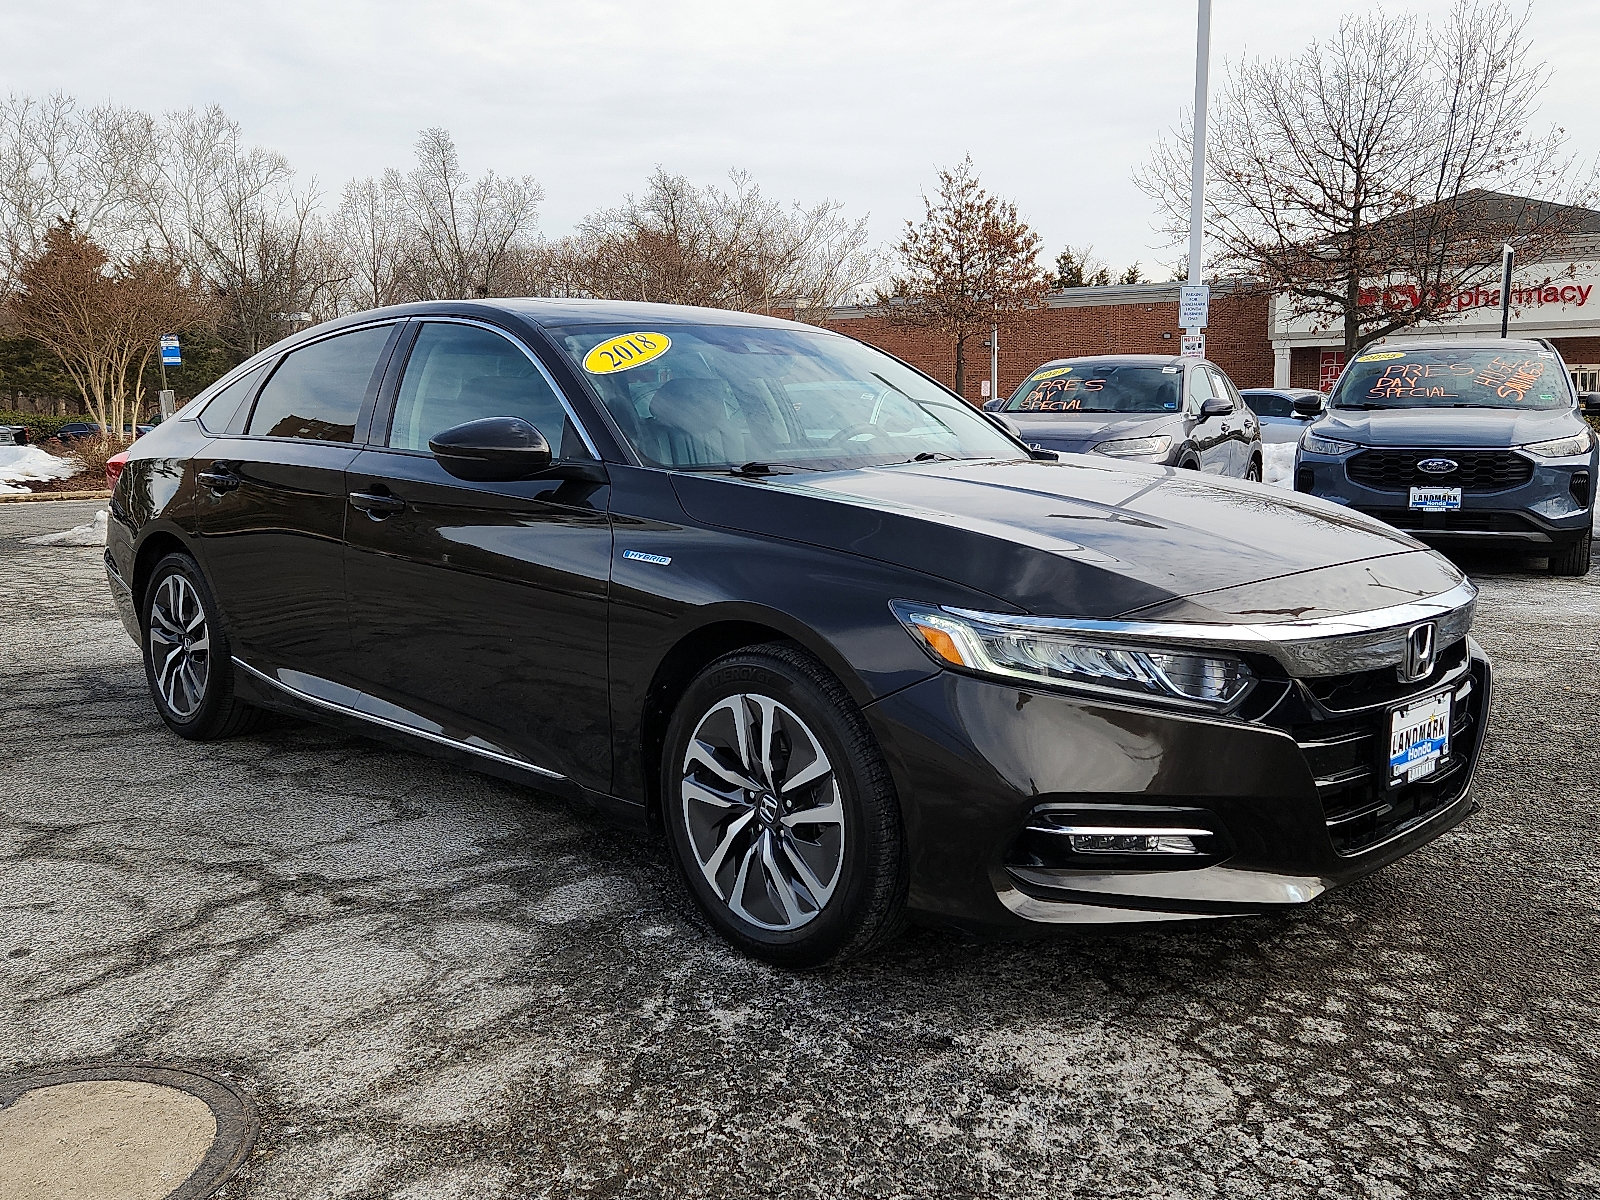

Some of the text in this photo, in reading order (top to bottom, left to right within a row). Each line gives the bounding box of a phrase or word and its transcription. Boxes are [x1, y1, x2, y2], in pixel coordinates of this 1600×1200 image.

[1457, 284, 1593, 312] pharmacy
[600, 335, 656, 368] 2018
[1383, 363, 1475, 378] PRES
[1036, 379, 1107, 392] PRES
[1376, 376, 1418, 388] DAY
[1024, 390, 1057, 402] DAY
[1365, 386, 1459, 399] SPECIAL
[1019, 400, 1083, 411] SPECIAL
[1413, 494, 1458, 502] LANDMARK
[629, 552, 667, 563] HYBRID
[1392, 715, 1446, 755] LANDMARK
[1408, 741, 1432, 760] Honda
